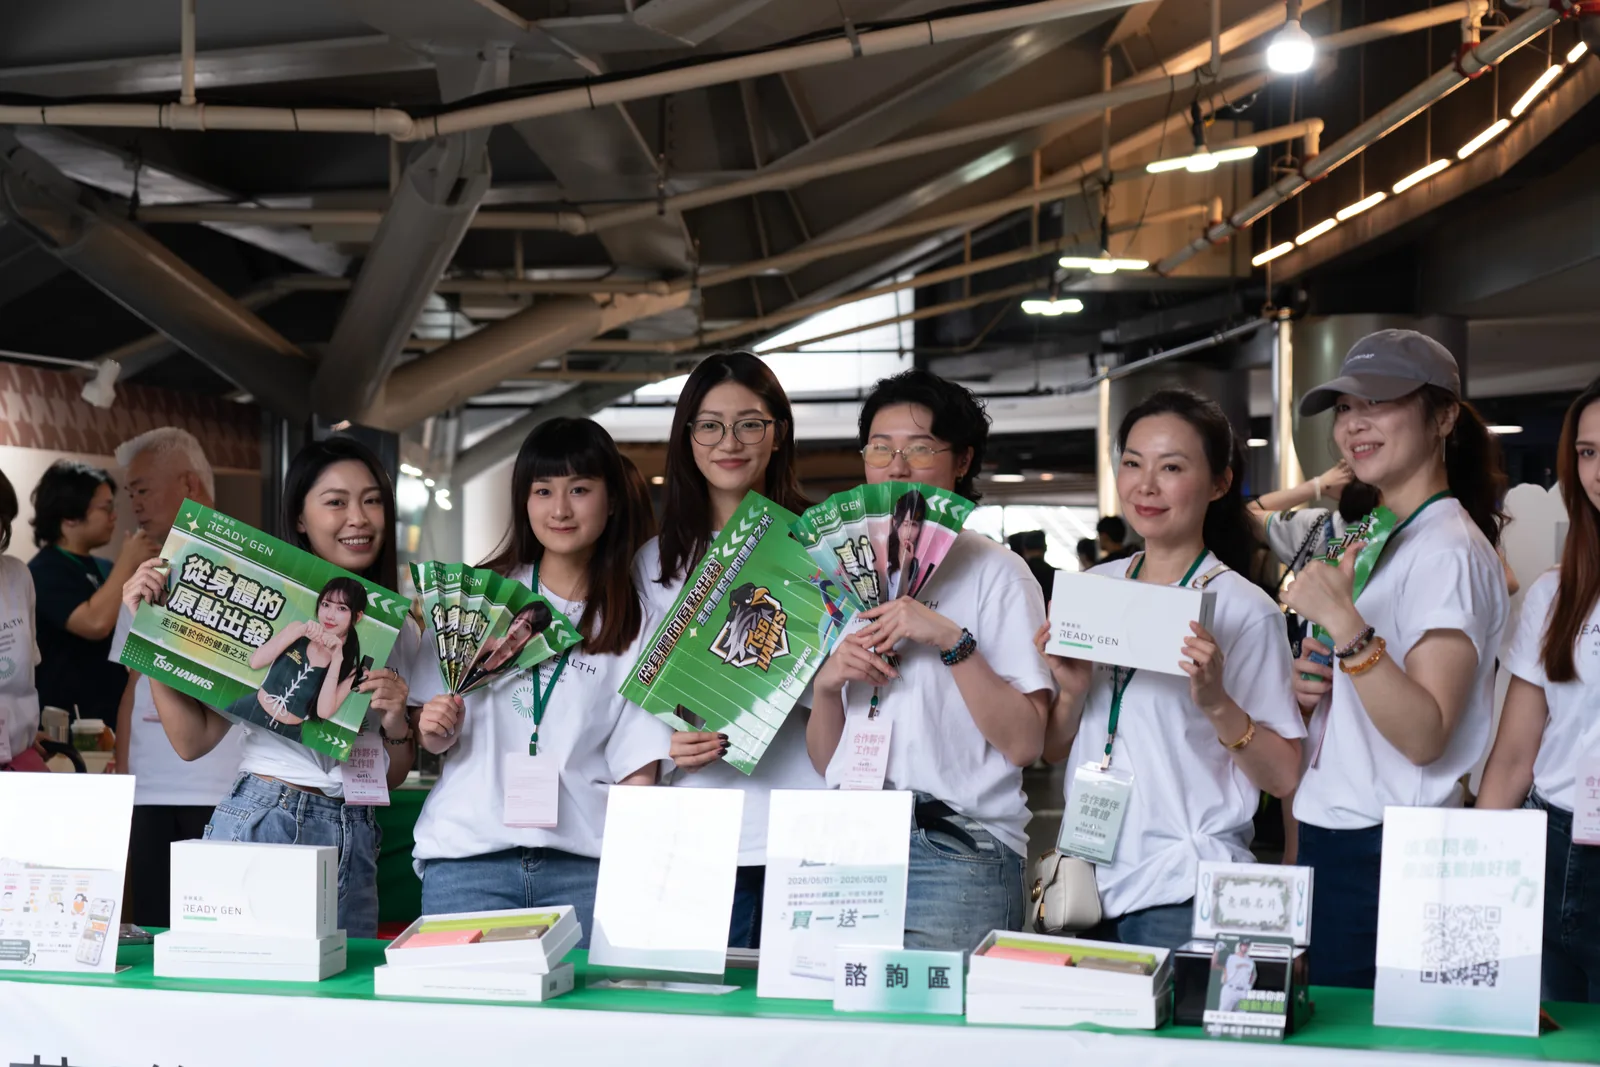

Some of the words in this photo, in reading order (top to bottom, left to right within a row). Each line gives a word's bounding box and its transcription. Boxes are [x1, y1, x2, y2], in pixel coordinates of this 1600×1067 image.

[810, 507, 839, 528] READY
[841, 499, 861, 512] GEN
[208, 520, 248, 544] READY
[249, 539, 274, 557] GEN
[430, 570, 462, 583] READY
[464, 575, 483, 587] GEN
[696, 514, 774, 627] 走向屬於你的健康之光
[181, 554, 285, 620] 從身體的
[0, 616, 24, 631] ALTH
[167, 583, 273, 647] 原點出發
[637, 558, 724, 686] 從身體的原點出發
[161, 617, 248, 662] 走向屬於你的健康之光
[745, 618, 770, 649] TSG
[756, 610, 787, 672] HAWKS
[1059, 629, 1095, 642] READY
[1097, 635, 1119, 646] GEN
[152, 652, 174, 672] TSG
[172, 666, 215, 690] HAWKS
[777, 675, 793, 691] TSG
[791, 646, 812, 677] HAWKS
[1080, 793, 1120, 812] 合作夥伴
[787, 876, 834, 885] 2026/05/01
[840, 875, 888, 884] 2026/05/03
[183, 904, 217, 914] READY
[220, 905, 242, 915] GEN
[790, 909, 880, 930] 買一送一
[844, 962, 951, 990] 諮詢區
